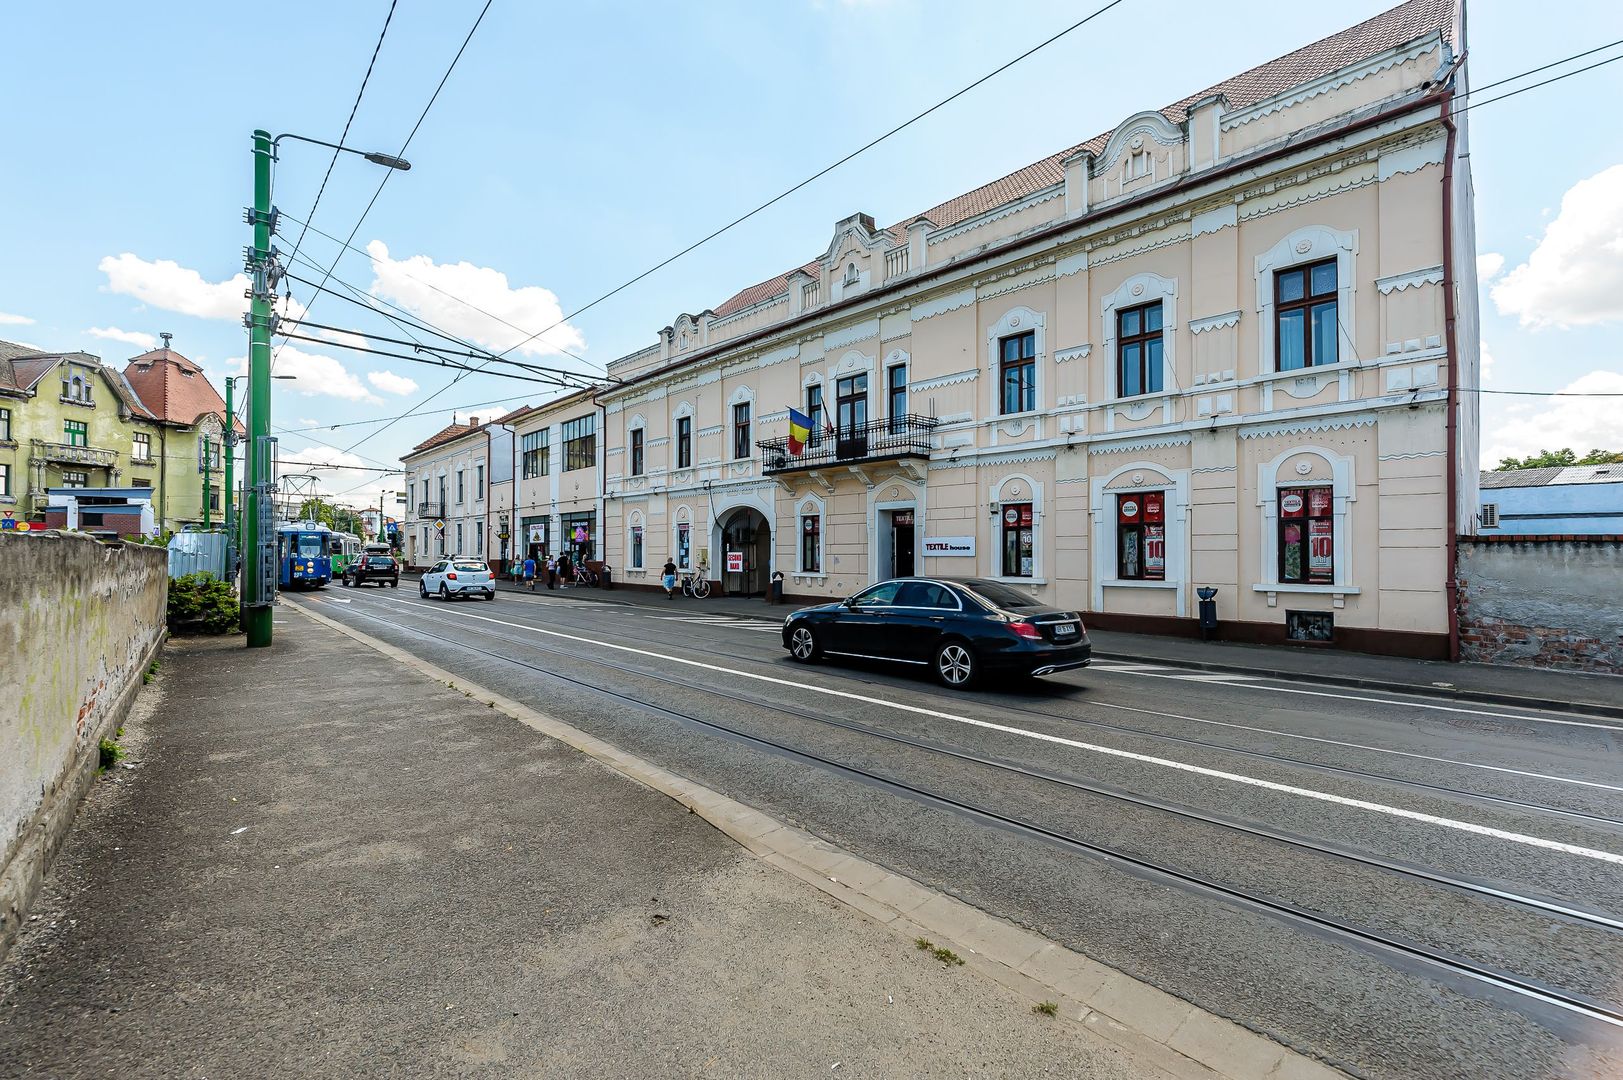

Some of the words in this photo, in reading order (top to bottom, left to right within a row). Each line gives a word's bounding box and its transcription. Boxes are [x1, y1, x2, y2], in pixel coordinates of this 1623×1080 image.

[926, 543, 948, 551] TEXTILE
[1147, 540, 1163, 558] 10
[1311, 536, 1331, 557] 10
